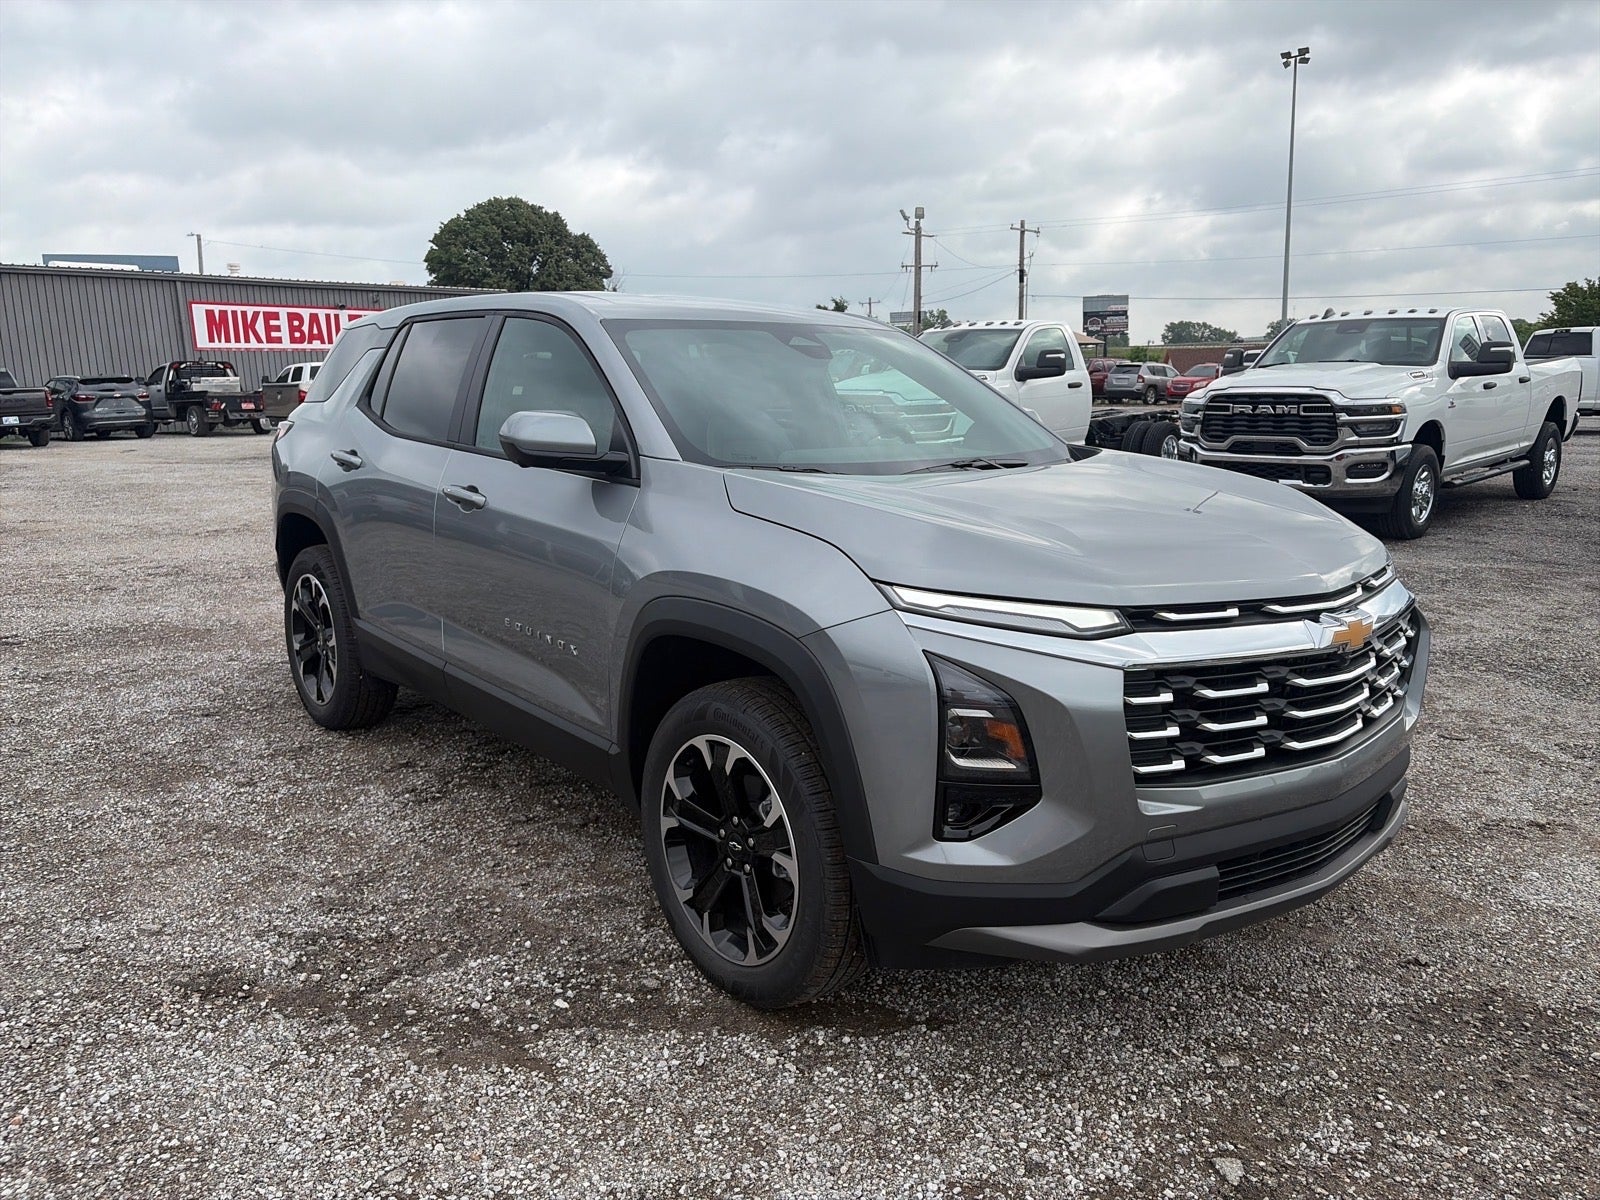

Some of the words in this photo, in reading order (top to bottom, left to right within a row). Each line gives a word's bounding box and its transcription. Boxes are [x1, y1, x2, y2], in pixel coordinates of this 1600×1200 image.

[204, 309, 283, 344] MIKE
[1233, 404, 1298, 415] RAM
[504, 617, 579, 656] EQUINOX
